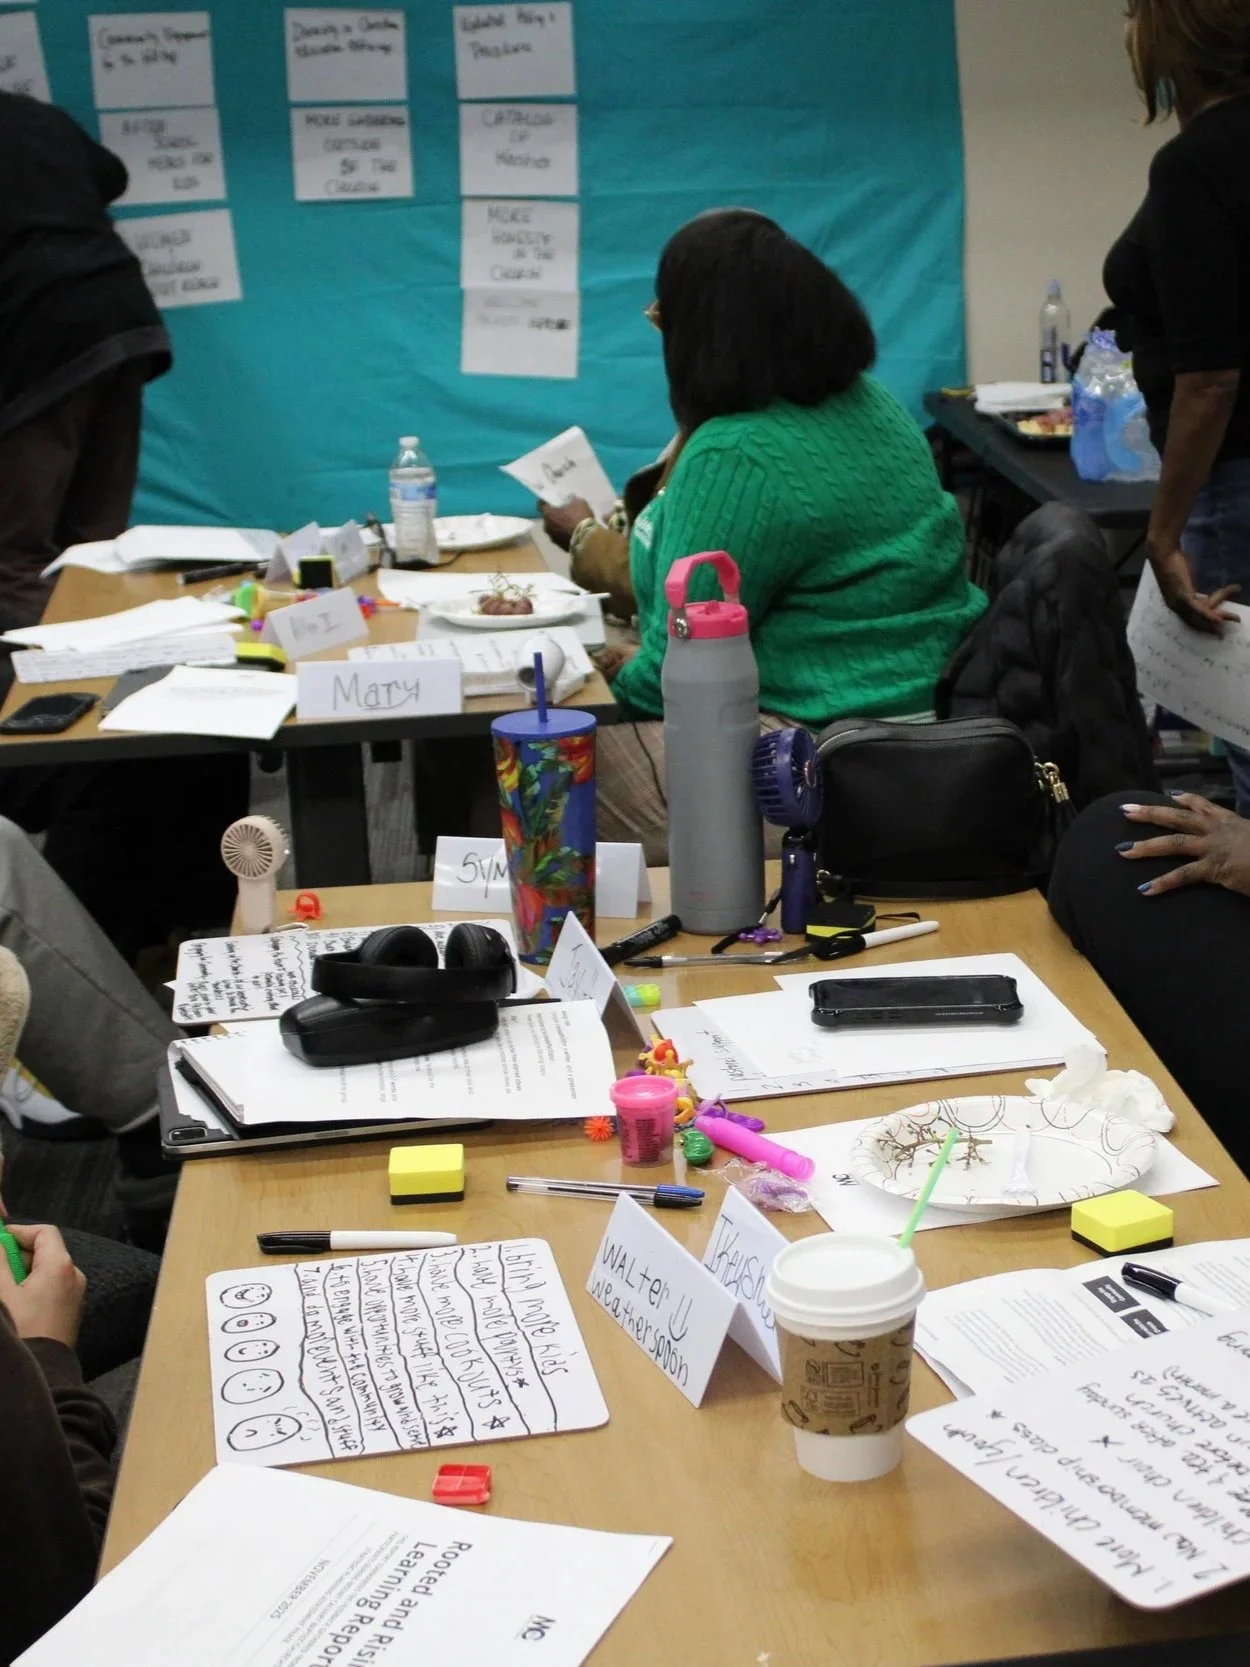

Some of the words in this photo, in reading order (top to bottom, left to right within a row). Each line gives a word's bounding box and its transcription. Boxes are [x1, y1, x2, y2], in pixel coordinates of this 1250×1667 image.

[487, 205, 532, 225] MORE
[332, 672, 421, 710] Mary
[520, 1299, 560, 1339] more
[289, 1560, 330, 1600] NOVEMBER
[356, 1542, 437, 1610] Learning
[411, 1542, 472, 1596] Rooted
[382, 1599, 418, 1630] and
